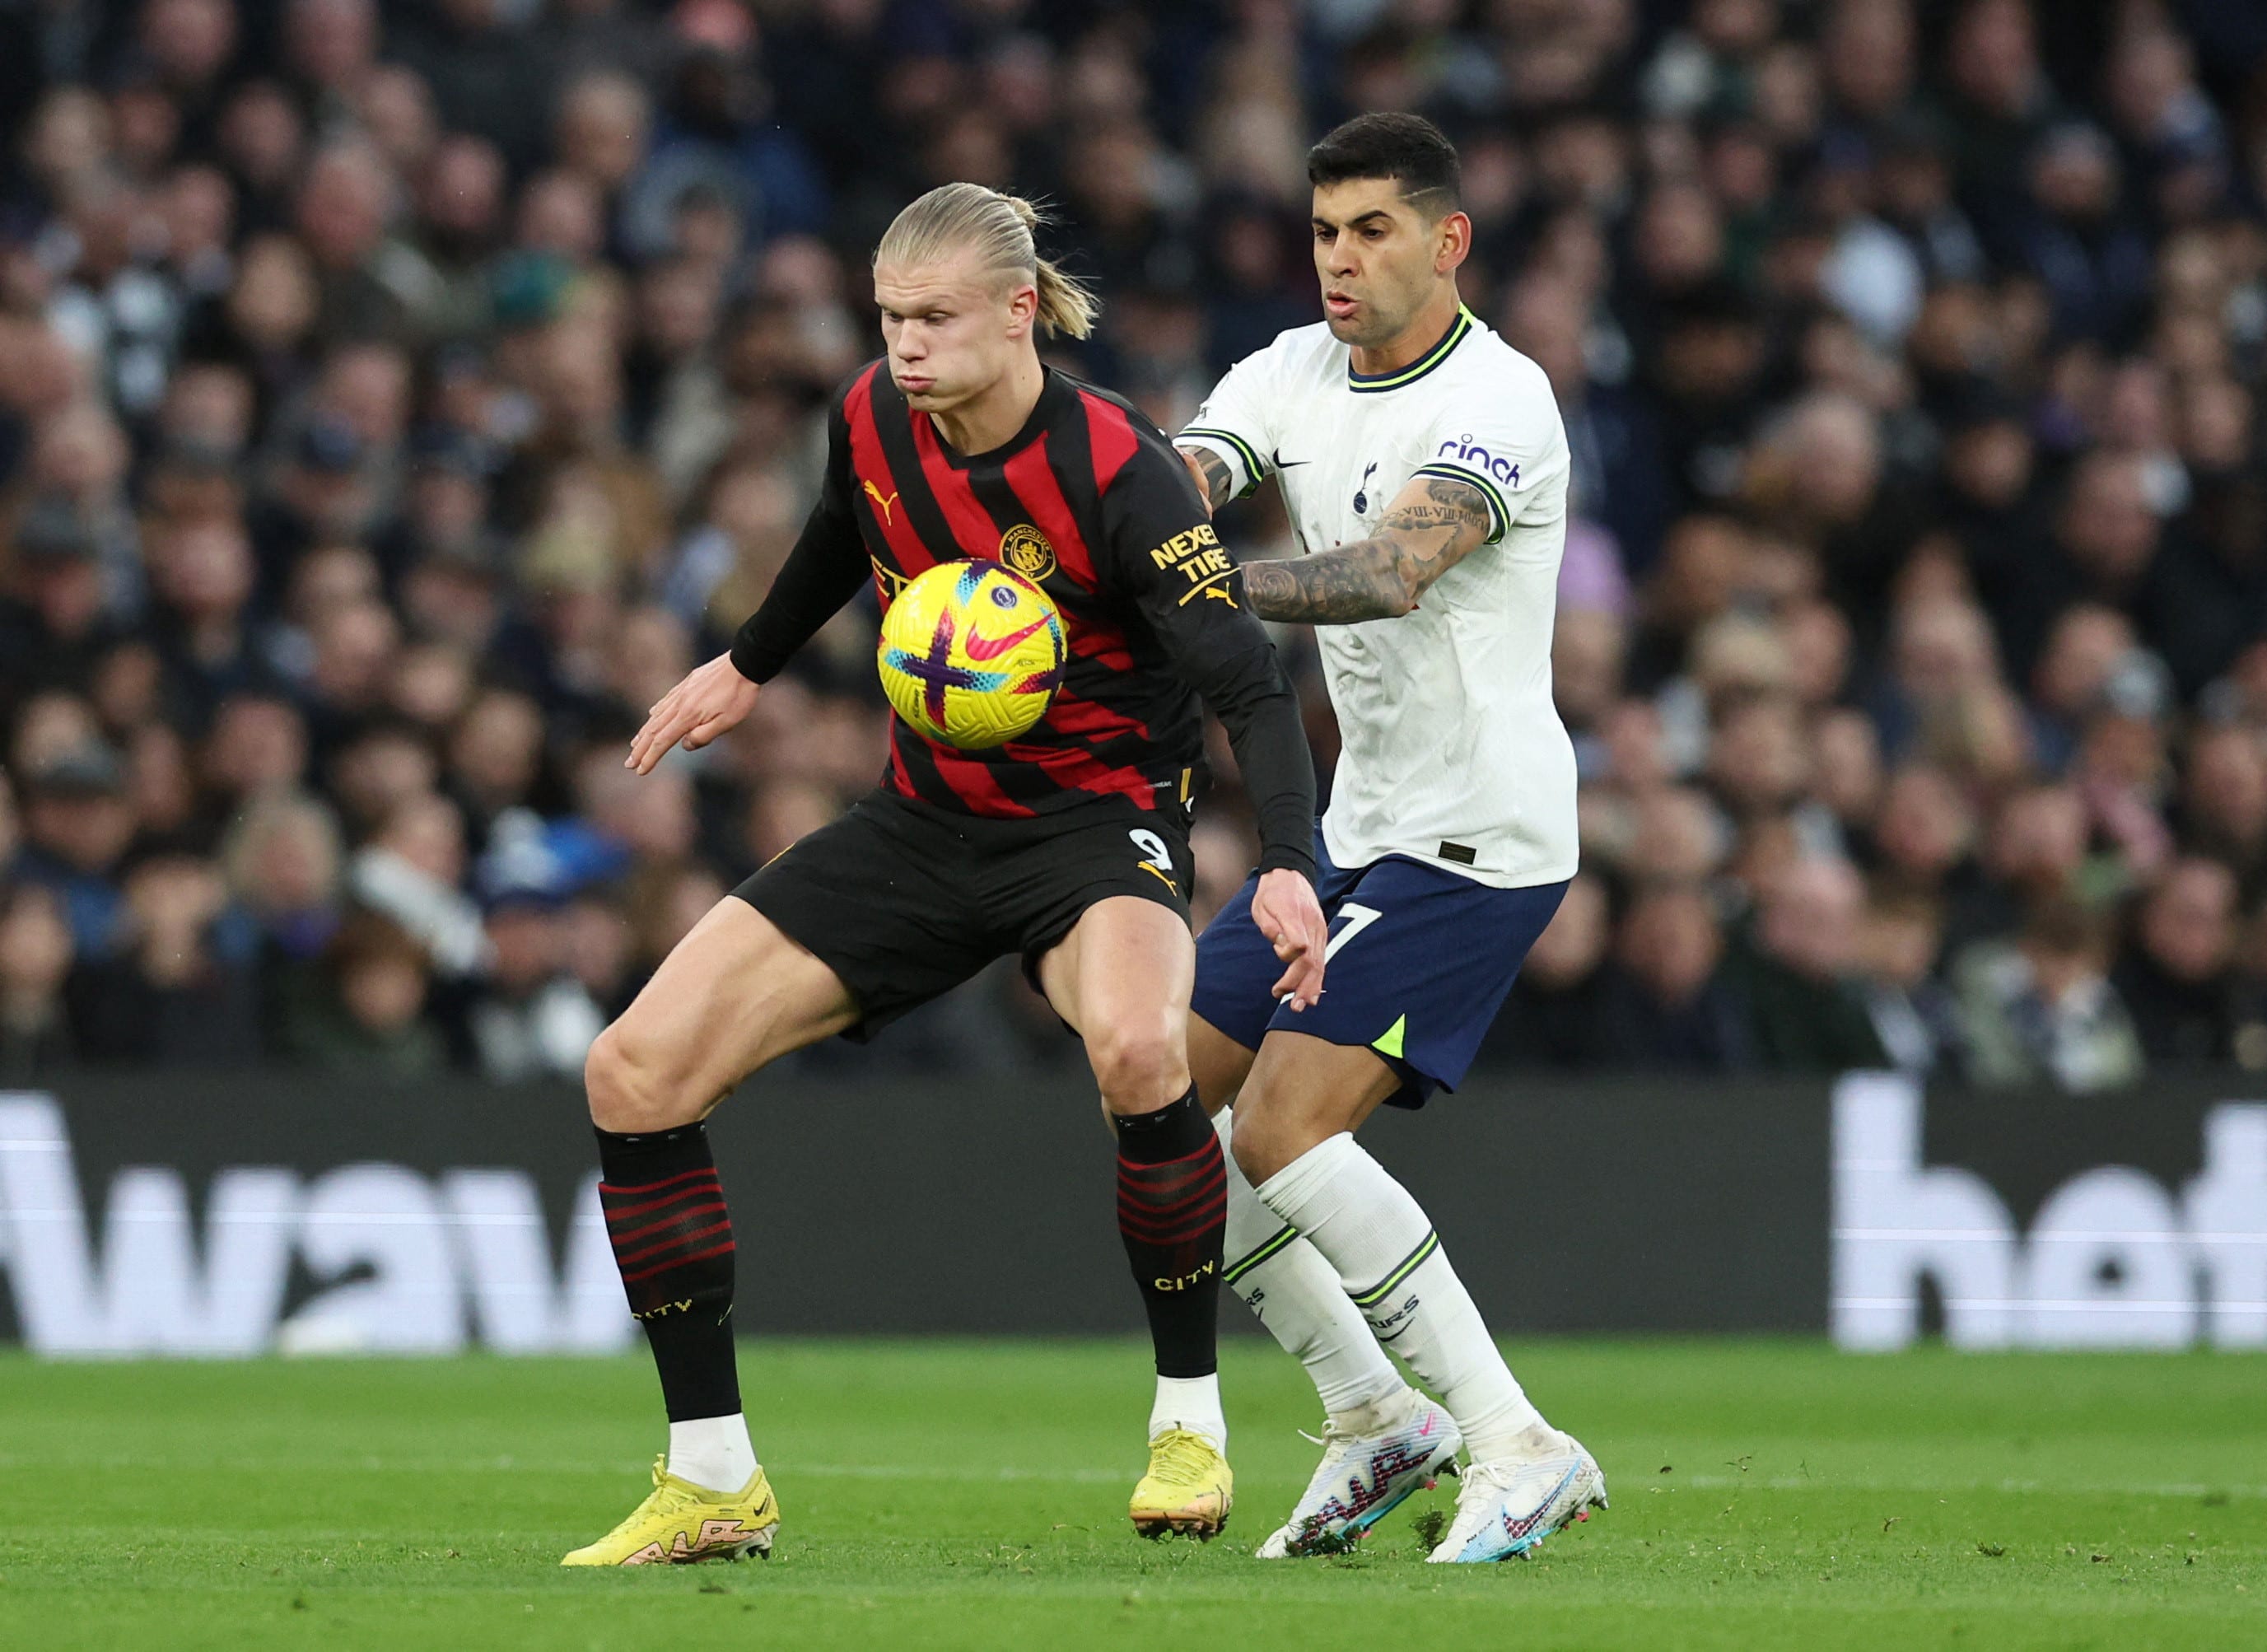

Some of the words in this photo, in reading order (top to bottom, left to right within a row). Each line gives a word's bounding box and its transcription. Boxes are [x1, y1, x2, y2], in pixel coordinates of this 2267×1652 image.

[1176, 548, 1231, 583] TIRE
[1128, 828, 1173, 870] 9
[1325, 903, 1383, 965] 7
[1154, 1260, 1214, 1290] CITY
